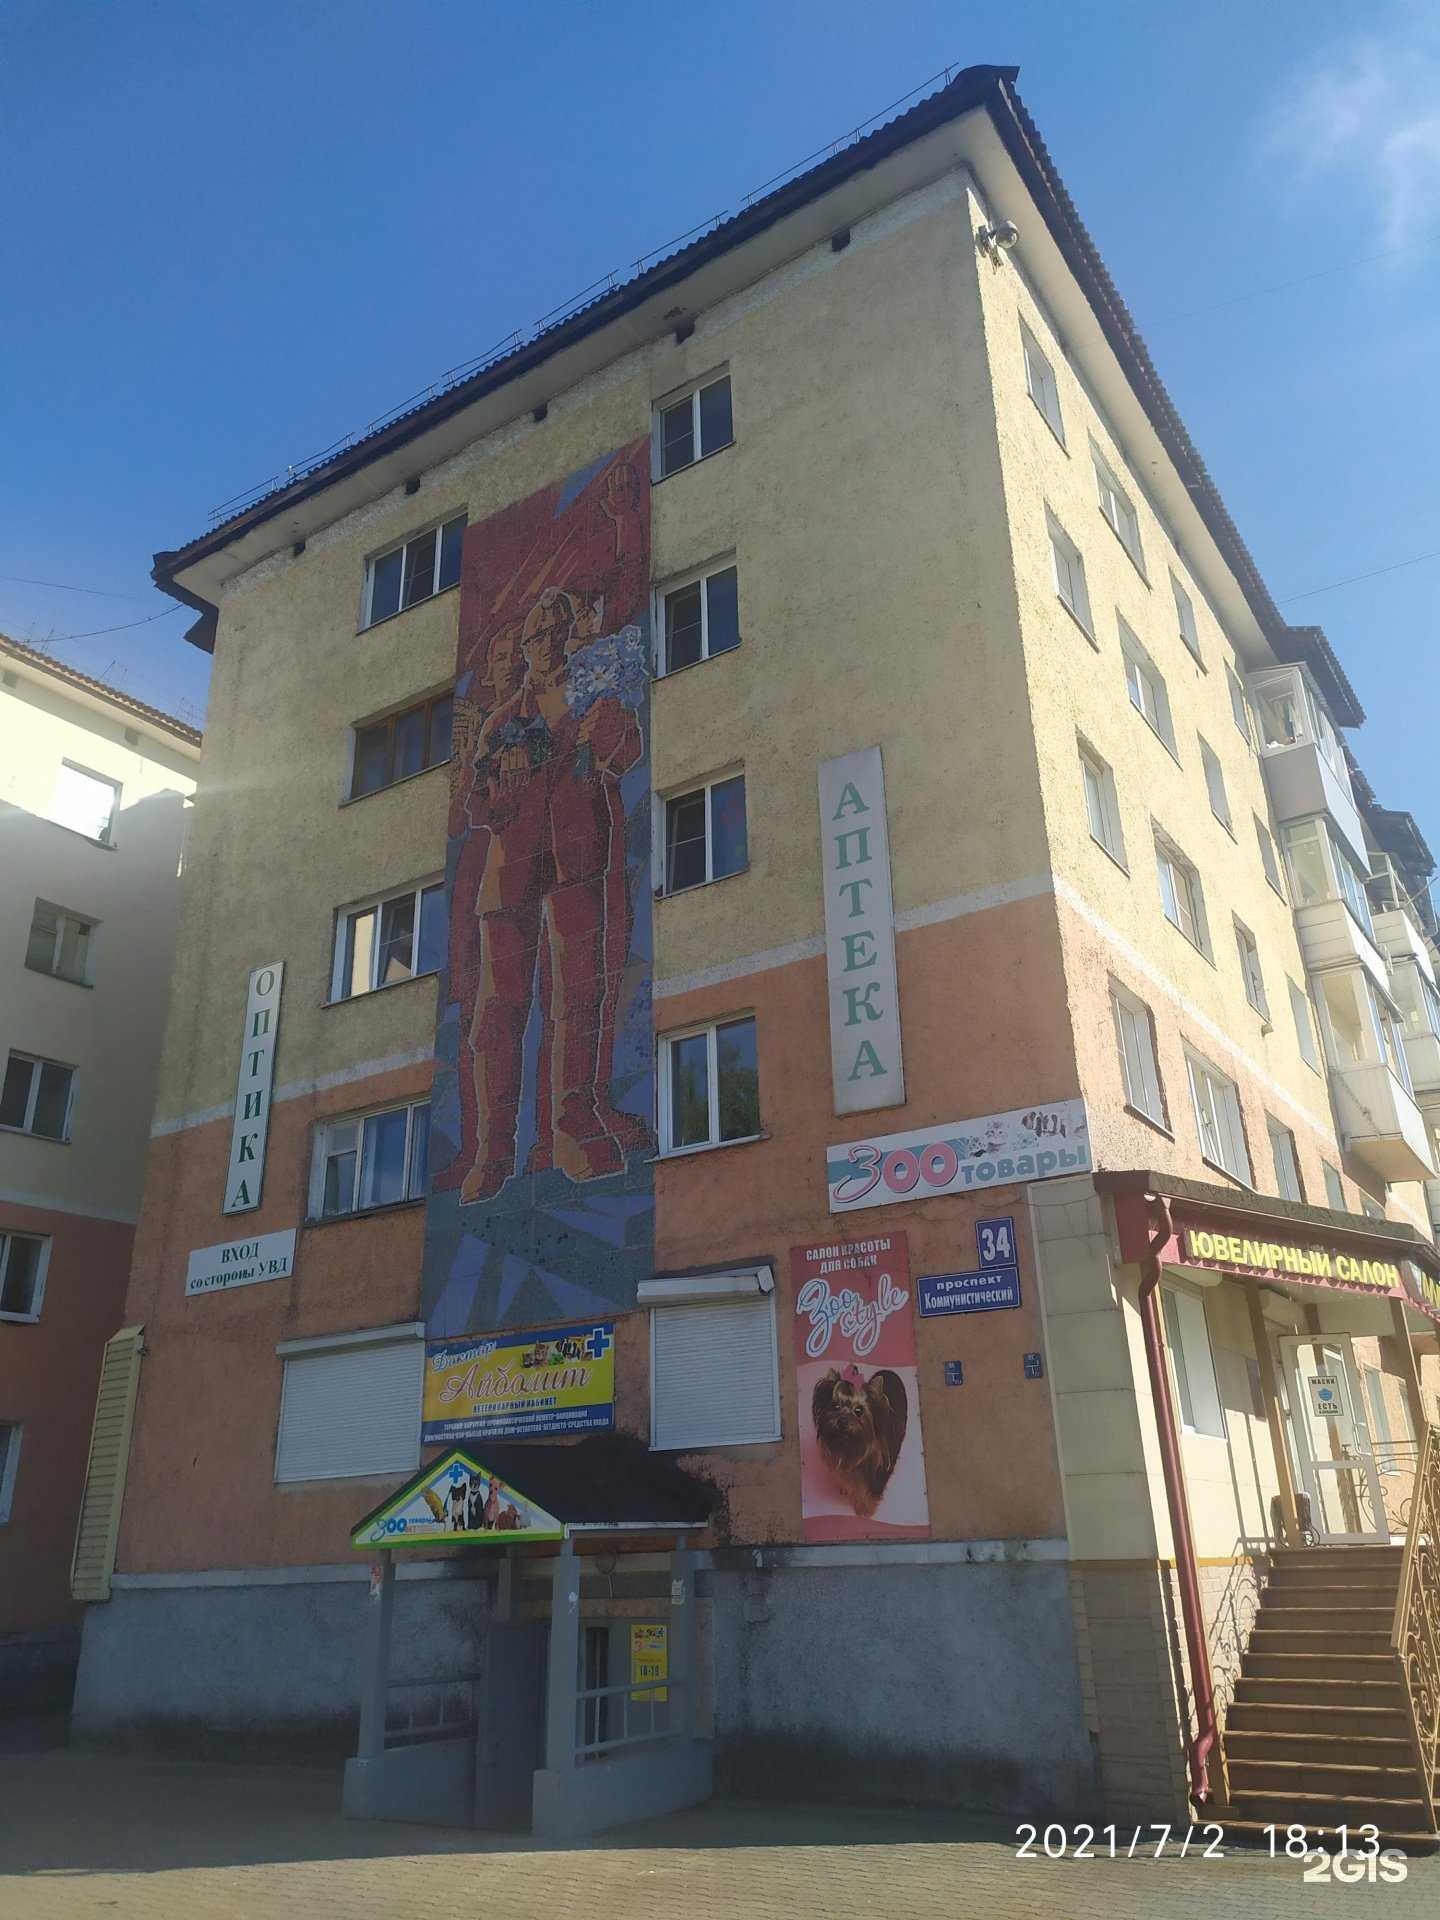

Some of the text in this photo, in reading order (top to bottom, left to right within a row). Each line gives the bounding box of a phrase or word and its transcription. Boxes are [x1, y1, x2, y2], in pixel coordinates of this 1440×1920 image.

[832, 781, 888, 1082] АПТЕКА
[232, 969, 275, 1207] ОПТИКА
[220, 1241, 260, 1264] ВХОД
[806, 1238, 891, 1261] САЛОН КРАСОТЫ
[981, 1226, 1011, 1261] 34
[258, 1257, 288, 1278] УВД
[819, 1255, 877, 1274] ДЛЯ СОБАК
[1189, 1230, 1400, 1289] ЮВЕЛИРНЫЙ САЛОН
[936, 1275, 1003, 1291] проспект
[924, 1286, 1014, 1310] Коммунистический
[439, 1363, 593, 1403] Айболит
[1317, 1402, 1338, 1410] ЕСТЬ
